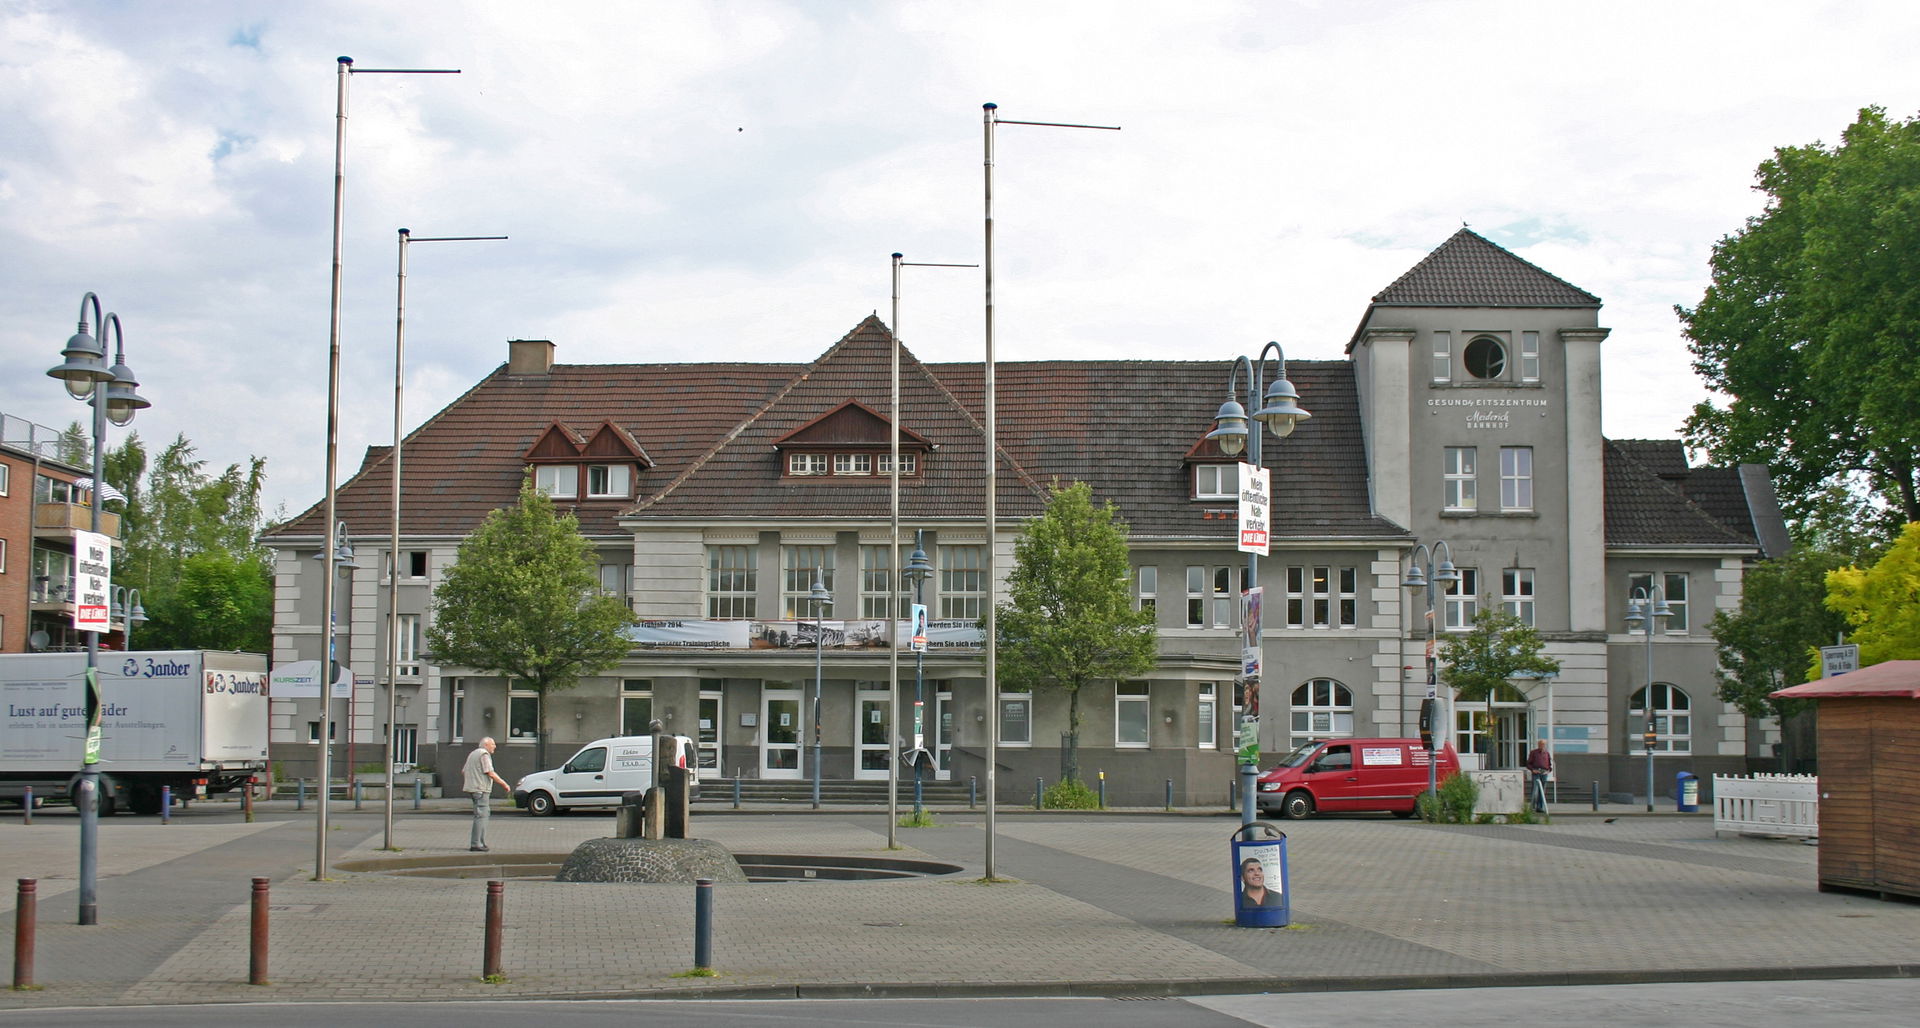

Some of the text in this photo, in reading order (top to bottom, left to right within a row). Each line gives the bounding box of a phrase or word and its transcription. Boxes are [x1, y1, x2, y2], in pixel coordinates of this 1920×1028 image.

[143, 658, 191, 678] Zander
[228, 674, 260, 695] Zander
[9, 704, 36, 717] Lust
[39, 703, 61, 717] auf
[101, 703, 128, 717] äder
